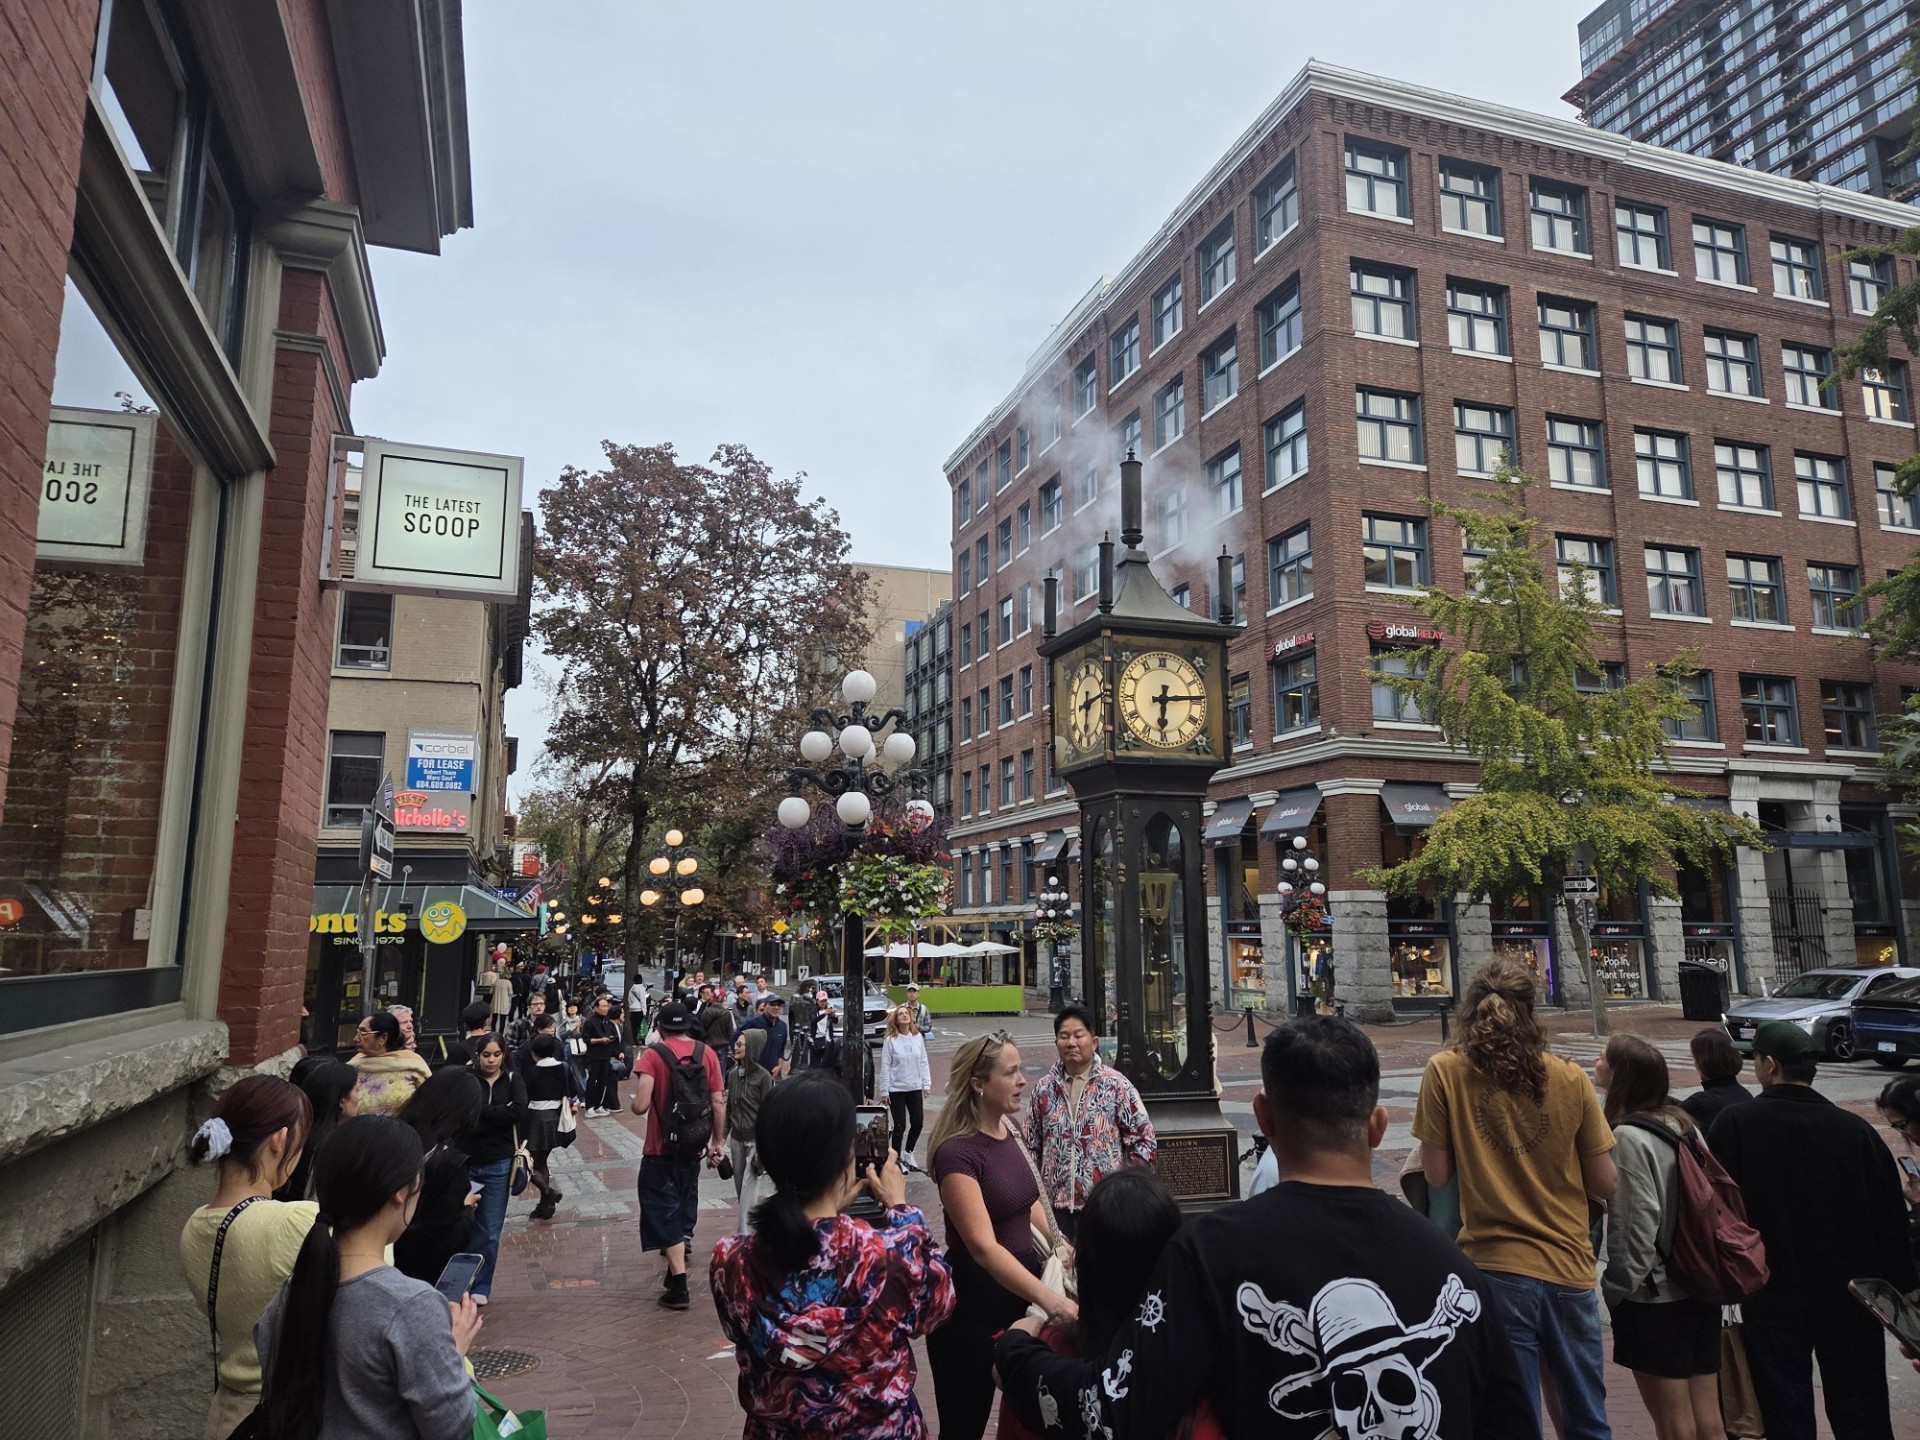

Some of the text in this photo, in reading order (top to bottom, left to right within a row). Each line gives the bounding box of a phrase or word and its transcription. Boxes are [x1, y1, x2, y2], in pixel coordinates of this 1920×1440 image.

[405, 494, 481, 514] THE LATEST
[404, 512, 480, 538] SCOOP
[1385, 624, 1417, 639] global
[1275, 634, 1296, 656] global
[424, 744, 469, 755] corbel
[417, 758, 465, 770] FOR LEASE
[1403, 802, 1431, 812] global
[333, 936, 405, 945] SINC 1979
[1604, 956, 1619, 968] Pop
[1596, 969, 1640, 979] Plant Trees
[1165, 1140, 1198, 1148] GASTOWN
[223, 1212, 235, 1230] PAST
